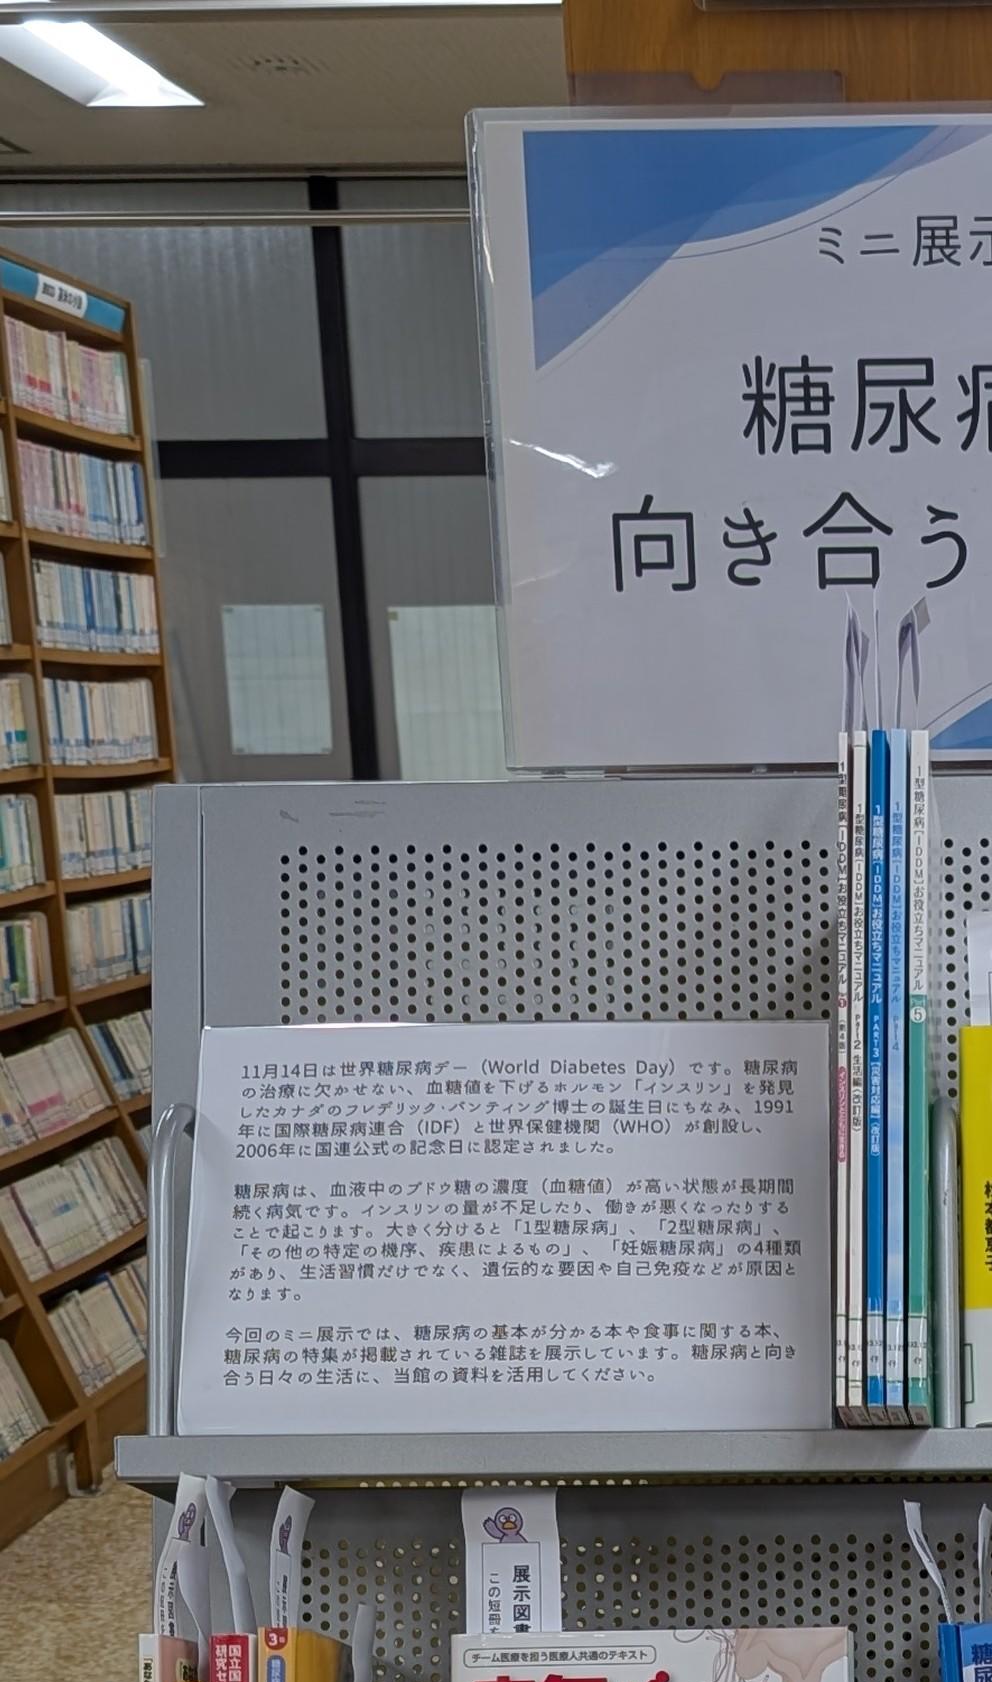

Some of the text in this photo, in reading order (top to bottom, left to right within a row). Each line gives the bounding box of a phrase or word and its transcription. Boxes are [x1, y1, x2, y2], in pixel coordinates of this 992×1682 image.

[550, 1059, 626, 1076] Diabetes
[242, 1079, 795, 1099] の治療に欠かせない、血糖値を下げるホルモン「インスリン」を発見
[235, 1138, 616, 1158] 2006年に国連公式の記念日に認定されました。
[232, 1198, 790, 1220] 続く病気です。インスリンの量が不足したり、働きが悪くなったりする
[229, 1260, 797, 1281] があり、生活習慣だけでなく、遺伝的な要因や自己免疫などが原因と
[228, 1285, 302, 1302] なります。
[225, 1321, 783, 1344] 今回のミニ展示では、糖尿病の基本が分かる本や食事に関する本、
[223, 1342, 797, 1364] 糖尿病の特集が掲載されている雑誌を展示しています。糖尿病と向き
[222, 1364, 658, 1387] 合う日々の生活に、当館の資料を活用してください。
[471, 1650, 648, 1664] チーム医療を担う医療人共通のテキスト
